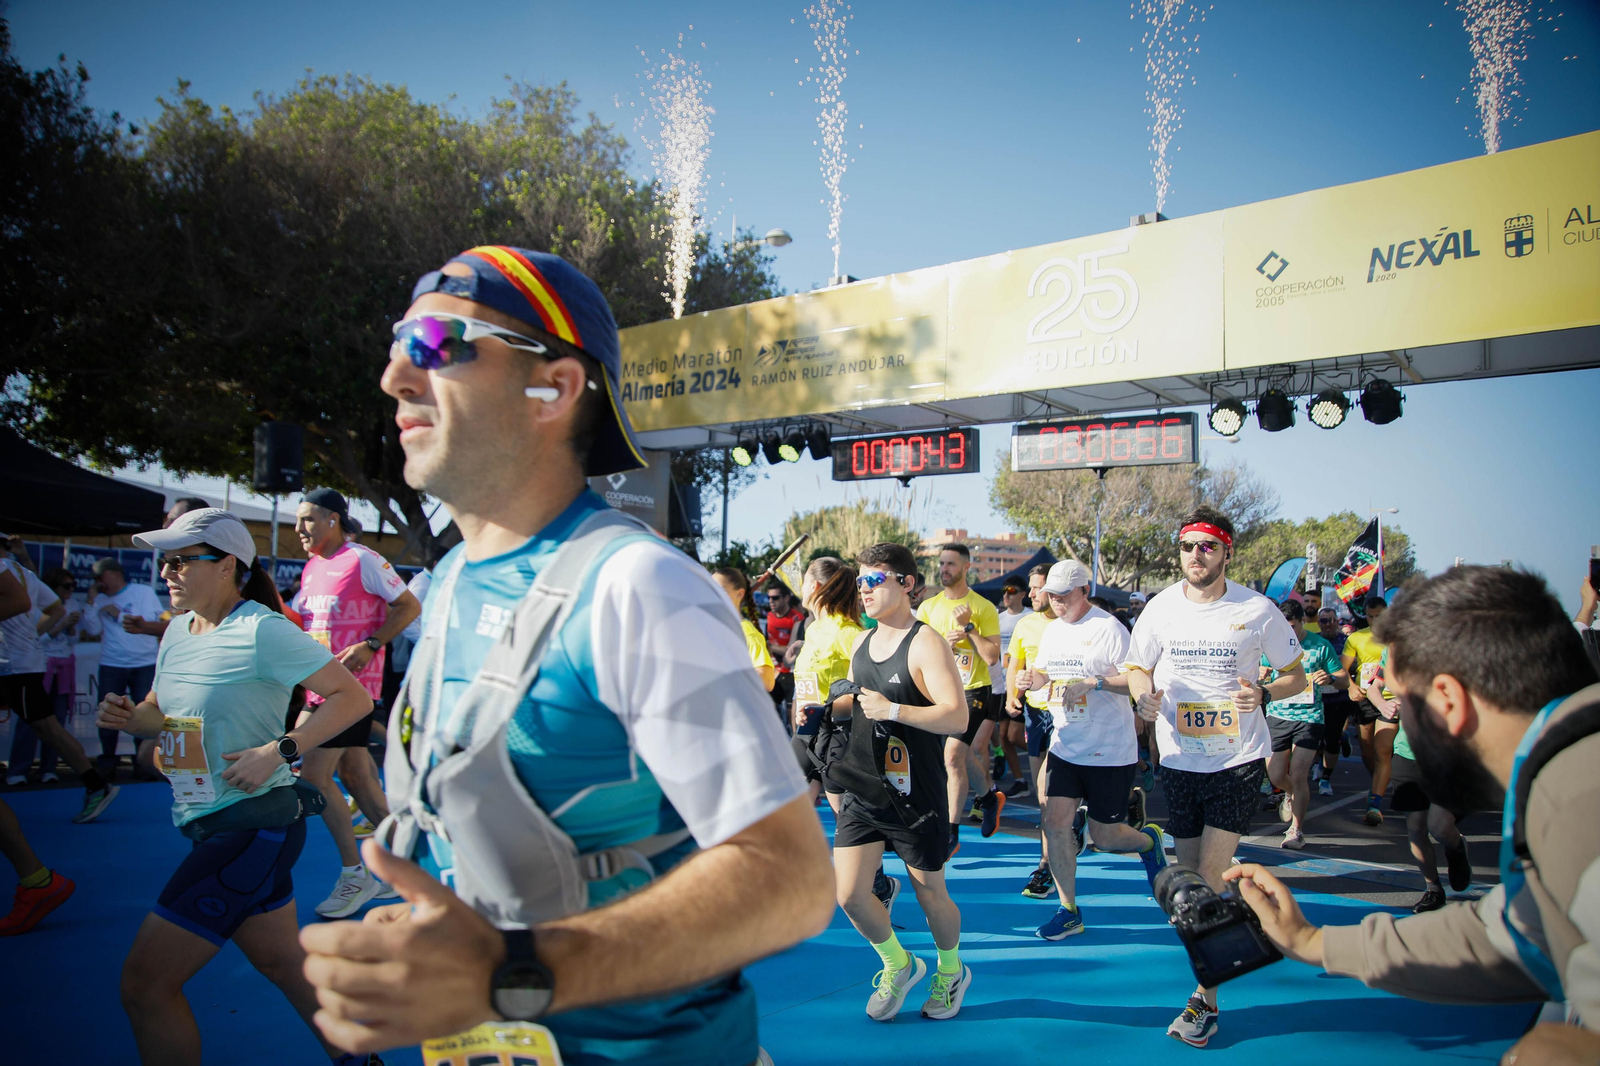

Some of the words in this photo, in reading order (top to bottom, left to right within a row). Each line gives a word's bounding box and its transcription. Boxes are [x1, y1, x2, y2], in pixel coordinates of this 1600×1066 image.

[1375, 272, 1397, 283] 2020
[1255, 275, 1344, 298] COOPERACIÓN
[1026, 244, 1140, 345] 25
[1255, 296, 1285, 309] 2005
[1027, 336, 1140, 373] EDICIÓN
[622, 358, 668, 379] Medio
[672, 346, 743, 371] Maratón
[751, 368, 797, 387] RAMÓN
[801, 363, 834, 379] RUIZ
[837, 353, 906, 375] ANDÚJAR
[621, 372, 685, 403] Almería
[689, 367, 741, 394] 2024
[605, 490, 655, 505] COOPERACIÓN
[1198, 640, 1238, 648] Maratón
[954, 653, 969, 666] 78
[1170, 648, 1207, 656] Almería
[1209, 648, 1238, 657] 2024
[1066, 659, 1083, 667] 2024
[795, 680, 815, 695] 93
[1055, 685, 1069, 698] 12
[1183, 710, 1233, 728] 1875
